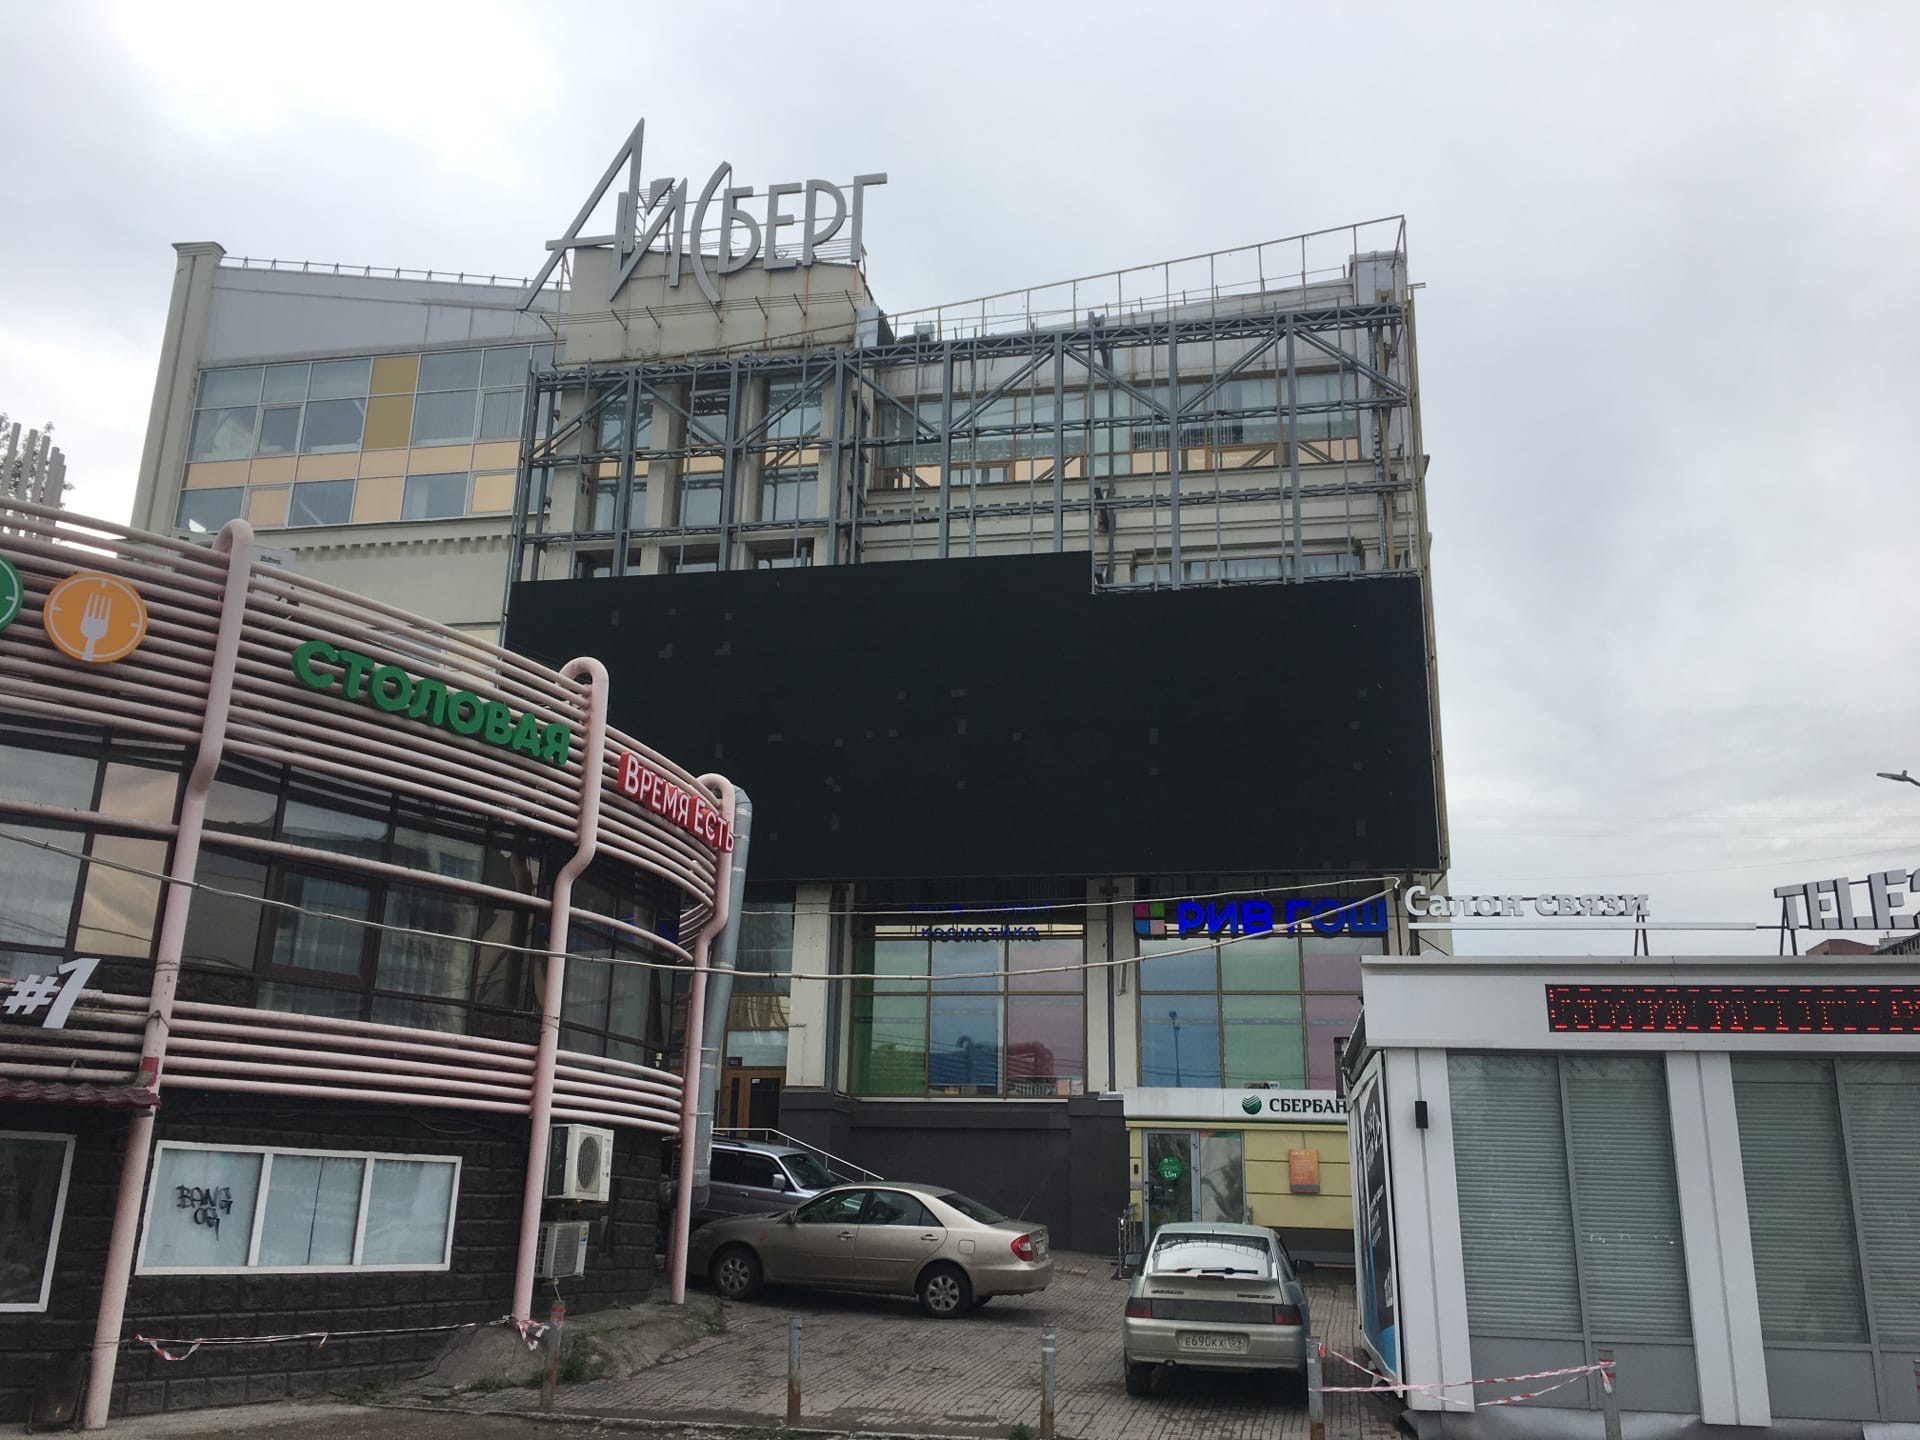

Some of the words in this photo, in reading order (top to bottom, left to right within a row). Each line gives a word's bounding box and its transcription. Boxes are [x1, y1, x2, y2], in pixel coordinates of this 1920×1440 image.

[292, 640, 571, 766] СТОЛОВАЯ
[693, 797, 734, 851] ЕСТЬ
[1176, 900, 1273, 936] РИВ
[1285, 898, 1388, 935] ГОШ
[1404, 885, 1524, 916] Салон
[1534, 893, 1650, 916] связи
[1774, 867, 1920, 930] TELE
[921, 927, 1039, 941] косметика
[2, 957, 102, 1030] #1
[1269, 1098, 1348, 1114] СБЕРБАН
